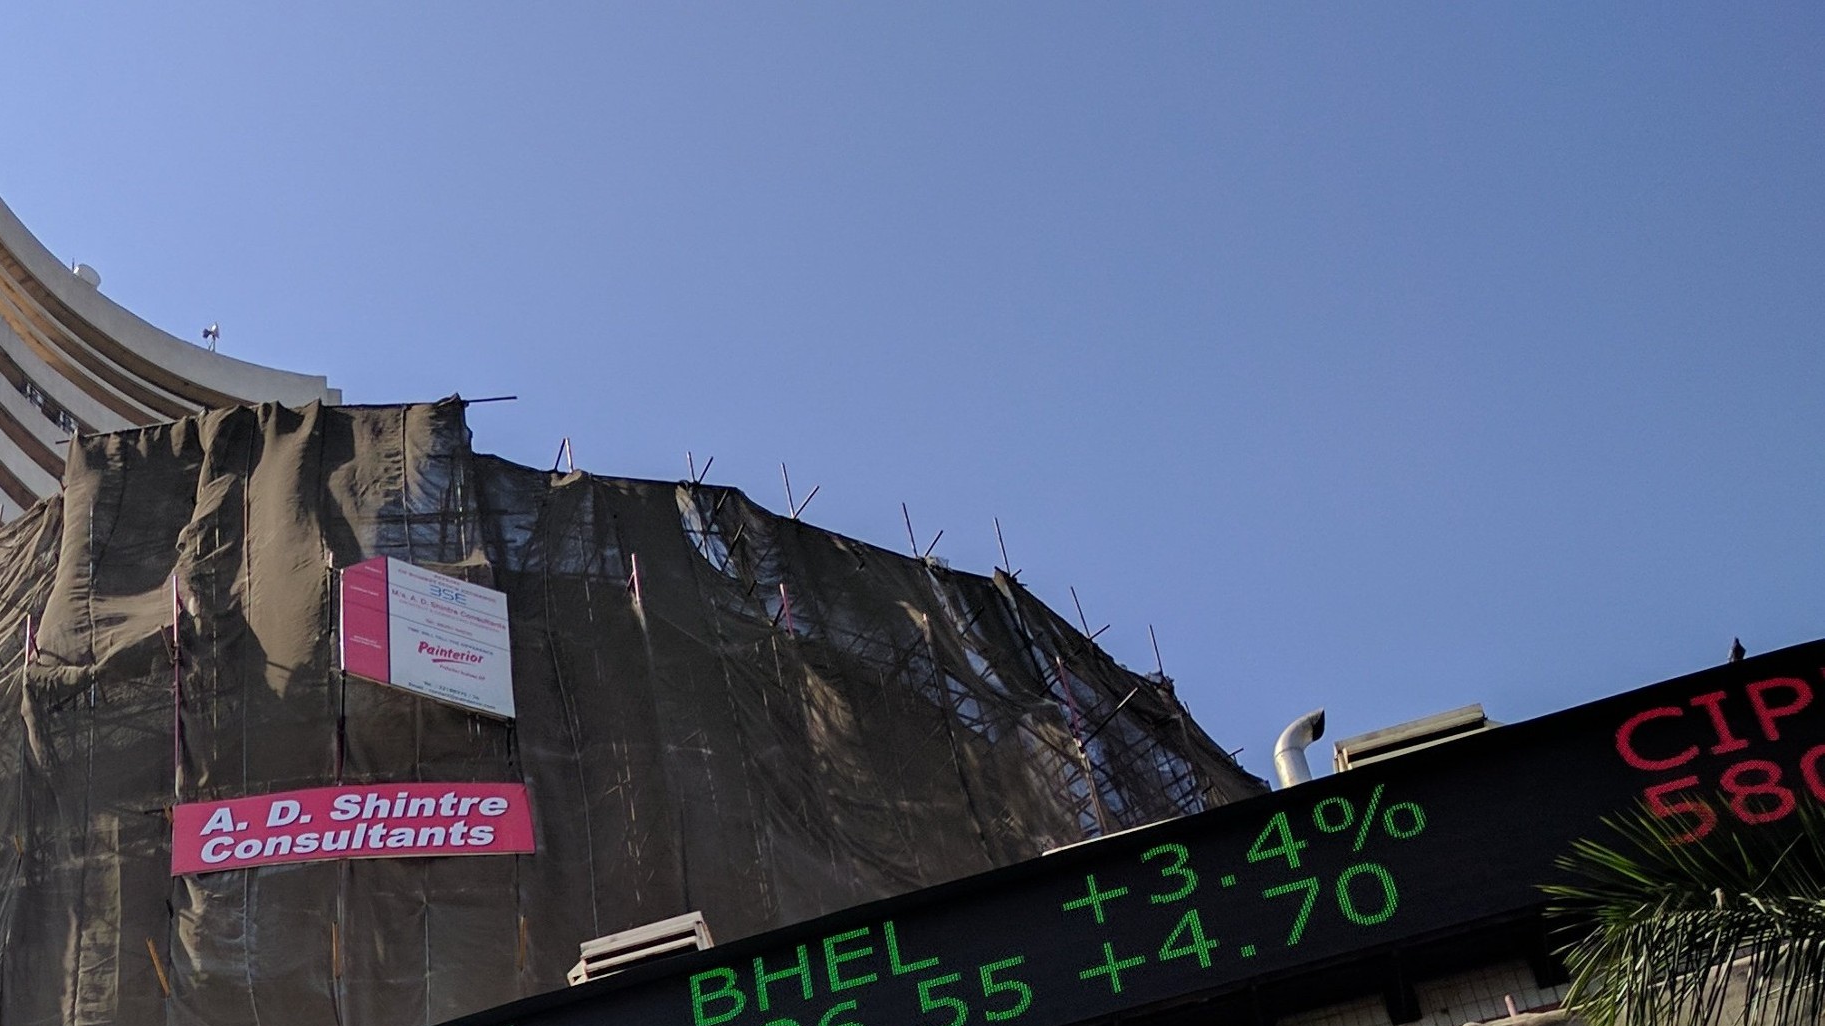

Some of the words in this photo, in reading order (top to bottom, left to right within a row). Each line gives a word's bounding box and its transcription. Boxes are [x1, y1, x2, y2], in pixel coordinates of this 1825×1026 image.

[418, 641, 484, 664] Painterior
[1616, 668, 1825, 771] CIP
[200, 808, 248, 836] A.
[266, 800, 311, 827] D.
[329, 791, 508, 822] Shintre
[200, 820, 495, 864] Consultants
[1063, 785, 1424, 924] +3.4%
[1079, 863, 1398, 994] +4.70
